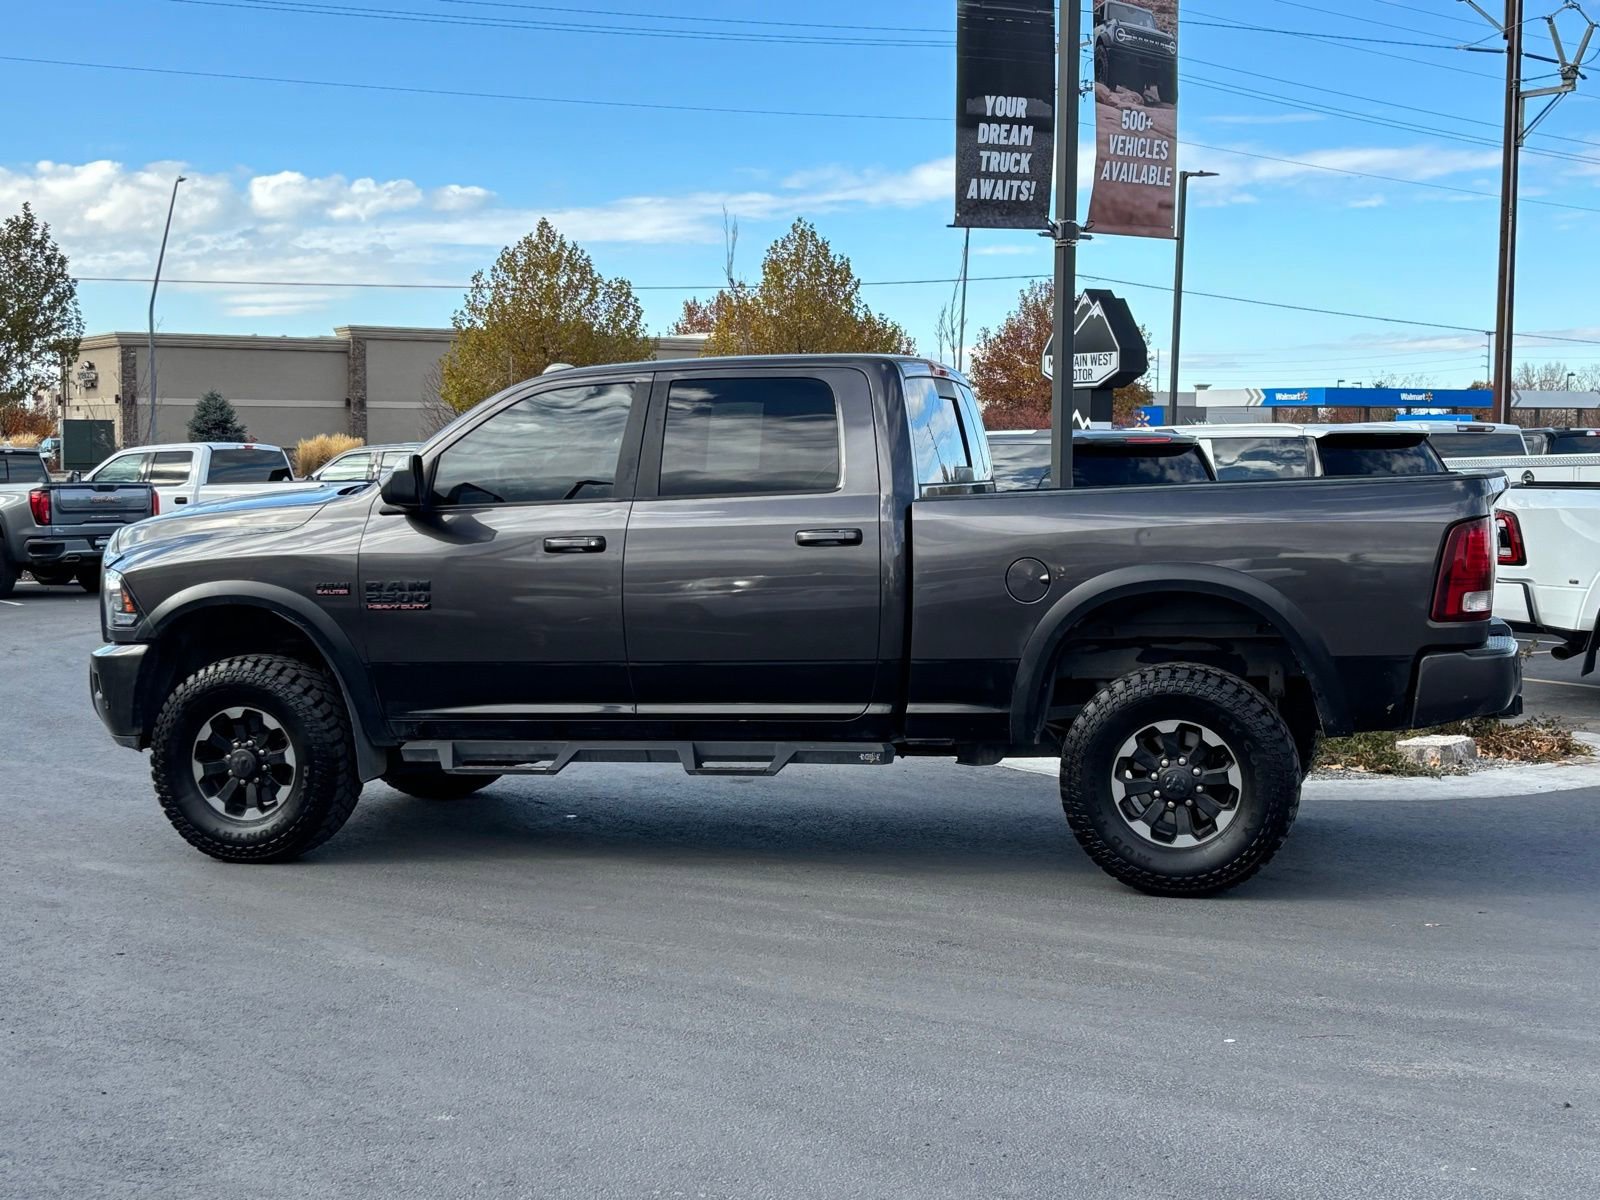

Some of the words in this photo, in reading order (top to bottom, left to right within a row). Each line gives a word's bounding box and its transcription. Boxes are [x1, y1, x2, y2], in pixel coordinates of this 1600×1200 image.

[984, 95, 1028, 118] YOUR
[1121, 109, 1154, 131] 500+
[977, 122, 1034, 146] DREAM
[1109, 134, 1169, 160] VEHICLES
[979, 150, 1032, 174] TRUCK
[1100, 160, 1172, 187] AVAILABLE
[966, 178, 1037, 202] AWAITS!
[1090, 353, 1113, 366] WEST
[1073, 368, 1093, 381] OTOR
[1275, 392, 1301, 401] Walmart
[1400, 392, 1426, 401] Walmart
[365, 580, 431, 592] RAM
[365, 592, 431, 603] 2500
